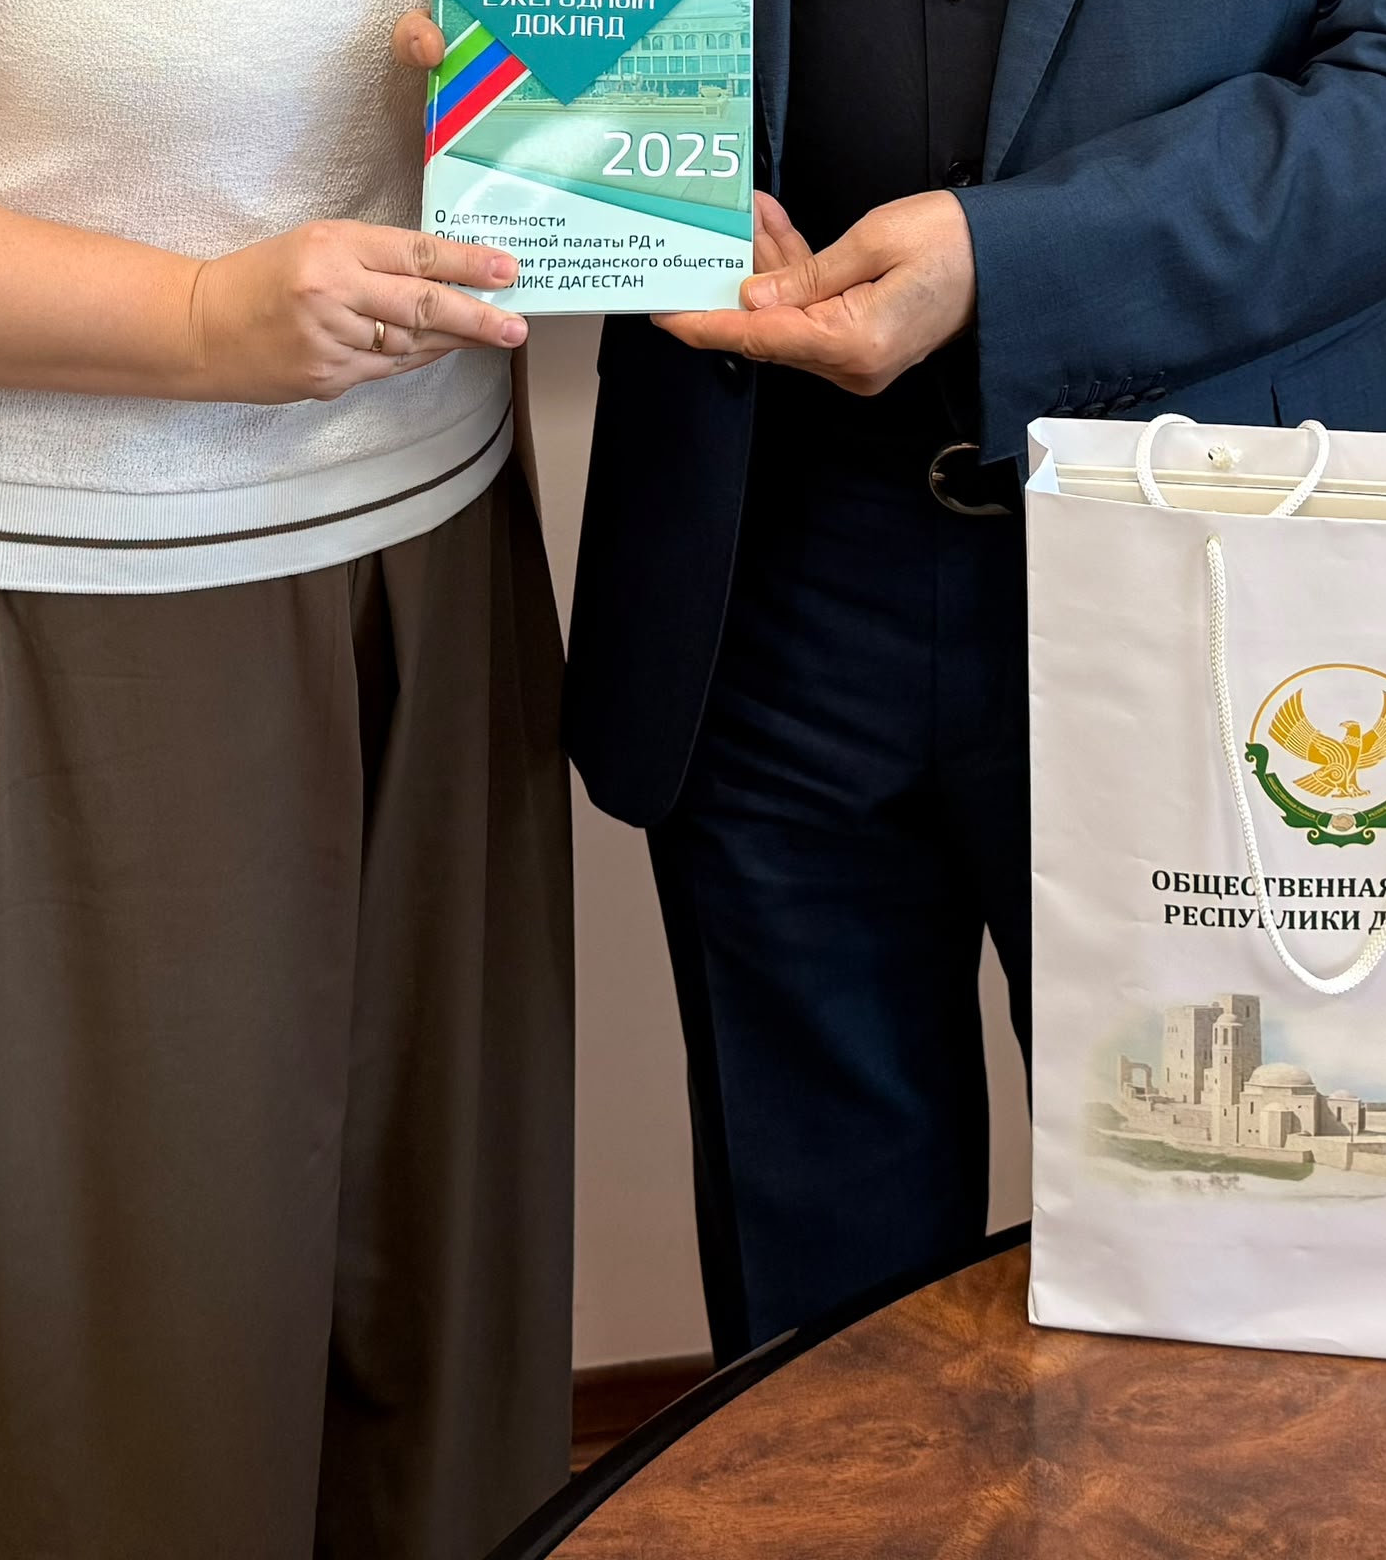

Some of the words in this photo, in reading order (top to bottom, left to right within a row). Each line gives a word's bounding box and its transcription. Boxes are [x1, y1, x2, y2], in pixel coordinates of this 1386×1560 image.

[511, 13, 625, 40] ДОКЛАД
[602, 132, 741, 178] 2025
[450, 213, 566, 228] деятельности
[563, 238, 624, 248] палаты
[629, 235, 651, 250] РД
[655, 239, 665, 248] и
[539, 256, 658, 271] гражданского
[663, 254, 744, 269] общества
[558, 274, 644, 290] ДАГЕСТАН
